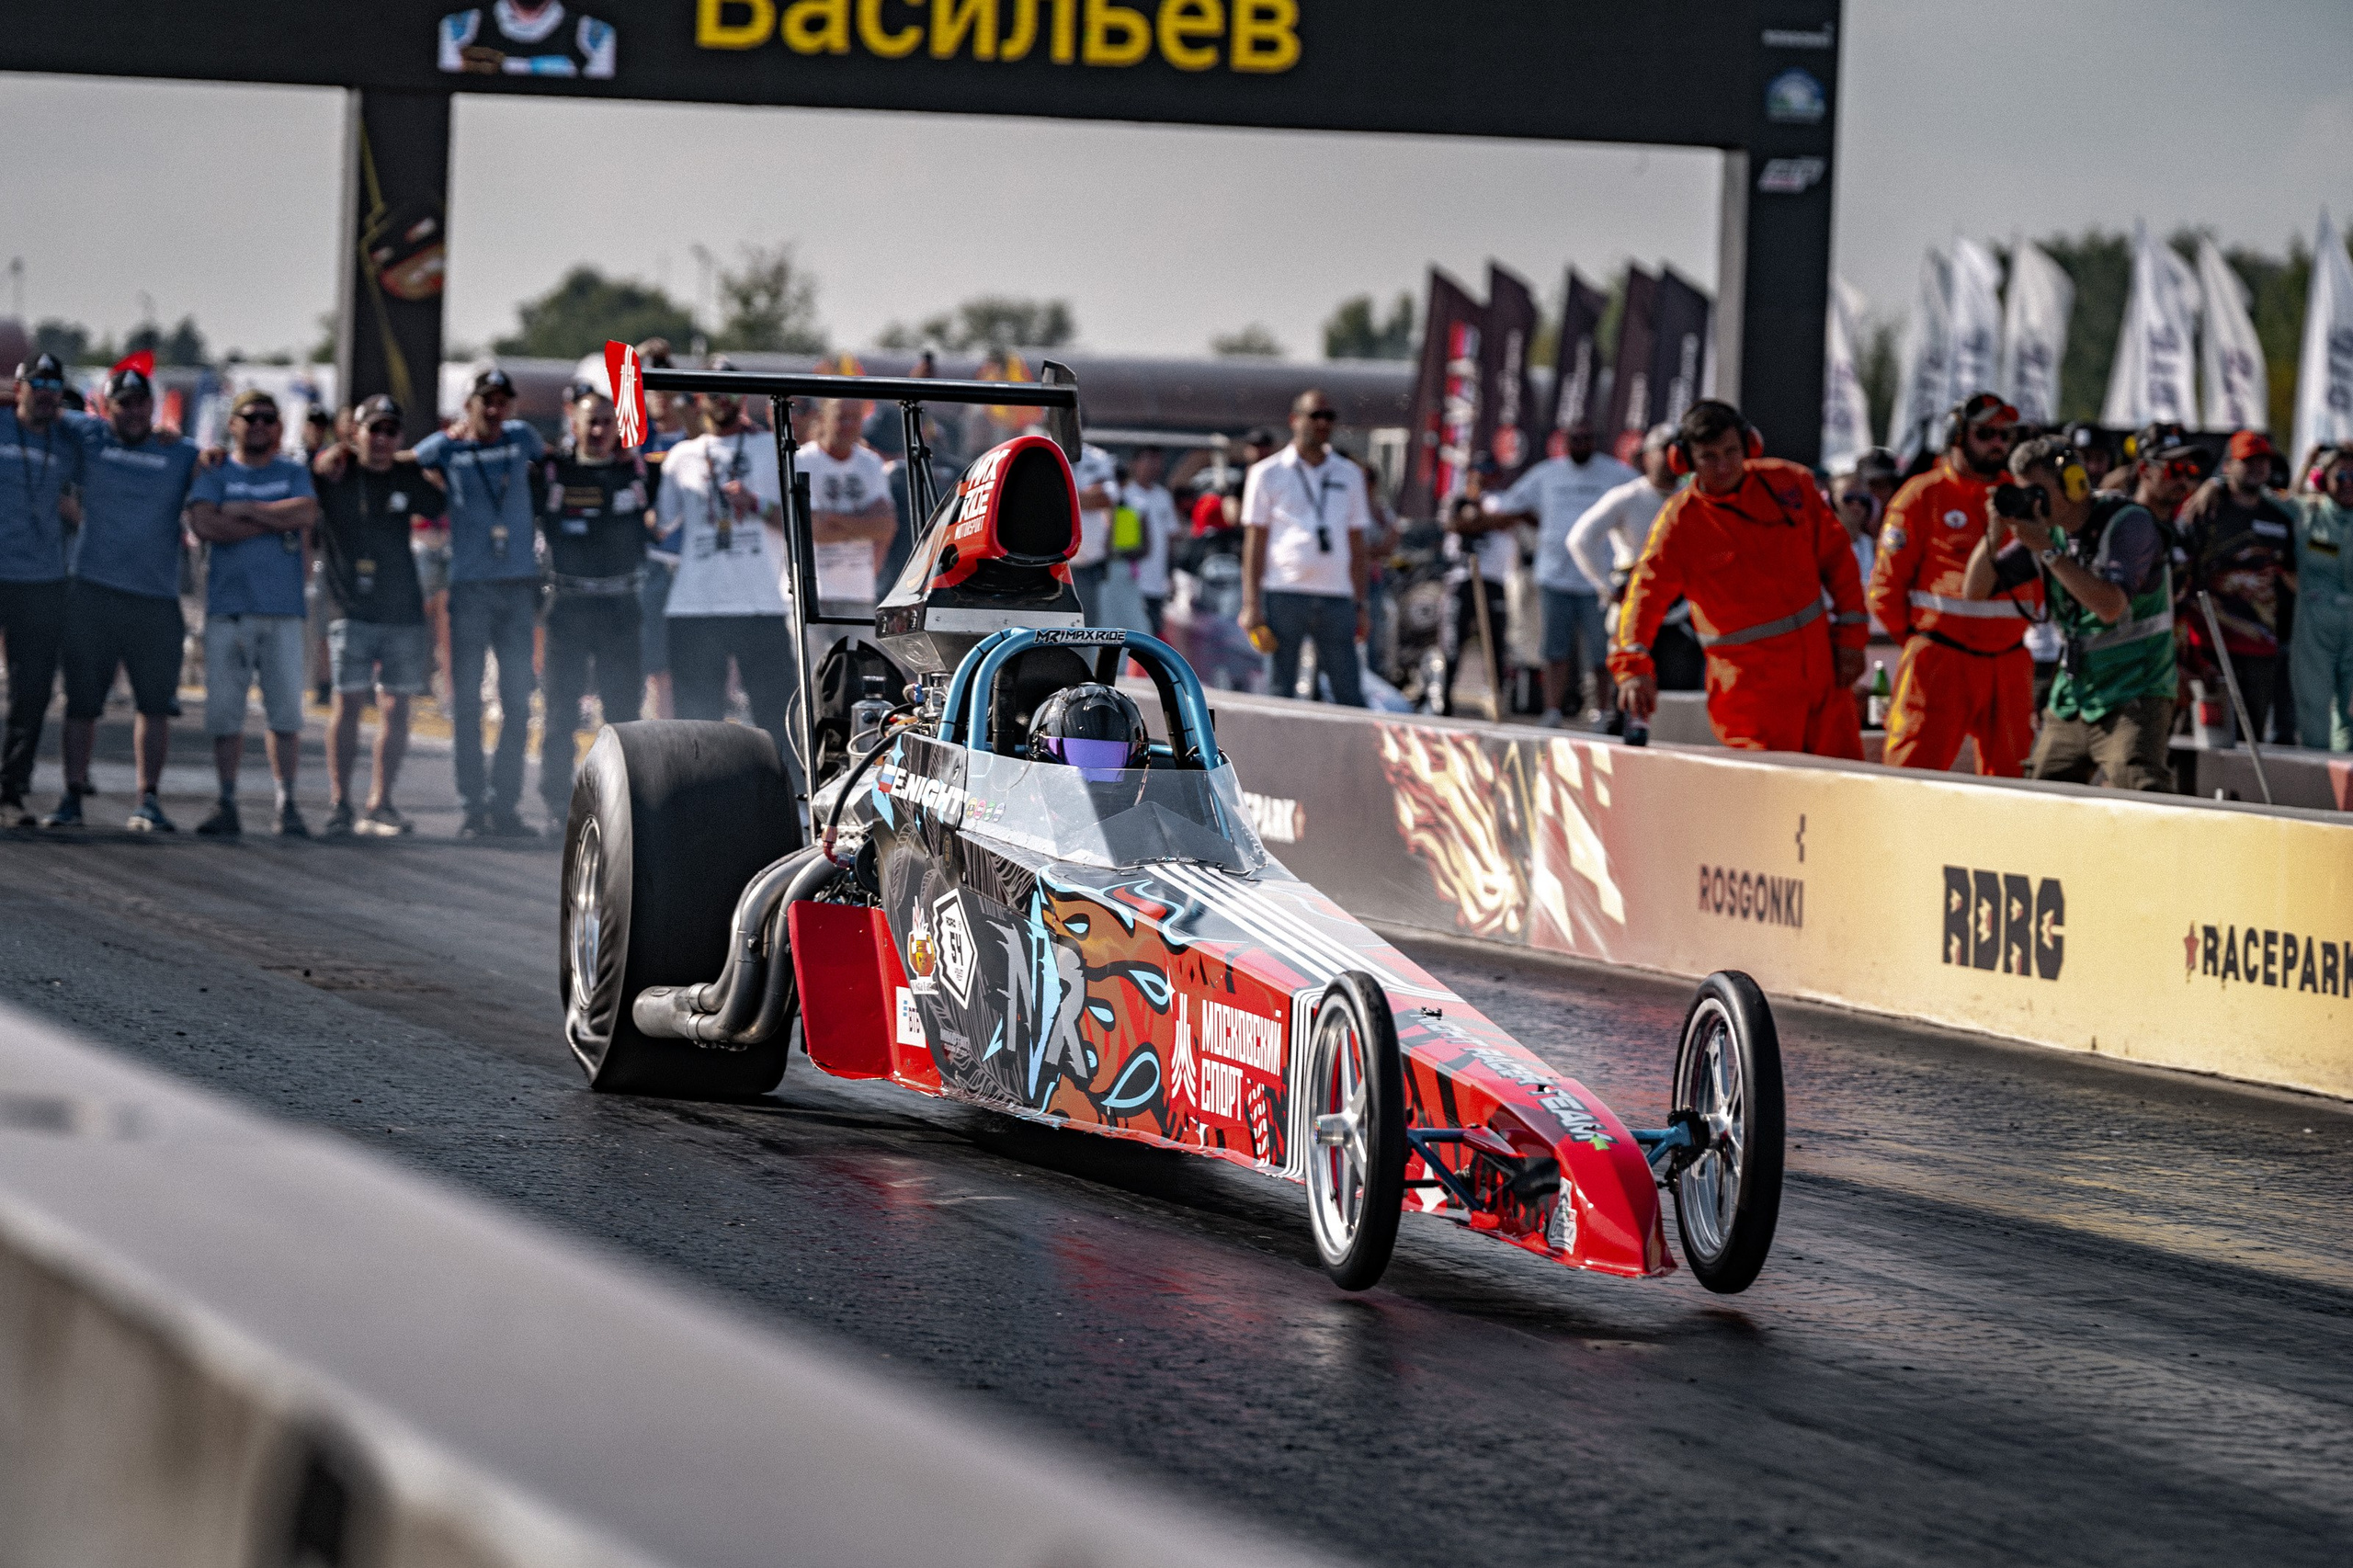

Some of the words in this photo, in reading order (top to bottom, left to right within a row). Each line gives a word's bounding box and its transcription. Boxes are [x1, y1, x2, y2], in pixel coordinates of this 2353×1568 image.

[1699, 866, 1804, 928] ROSGONKI
[1202, 999, 1282, 1076] МОСКОВСКИЙ
[1201, 1058, 1244, 1121] СПОРТ
[1529, 1087, 1616, 1142] TEAM
